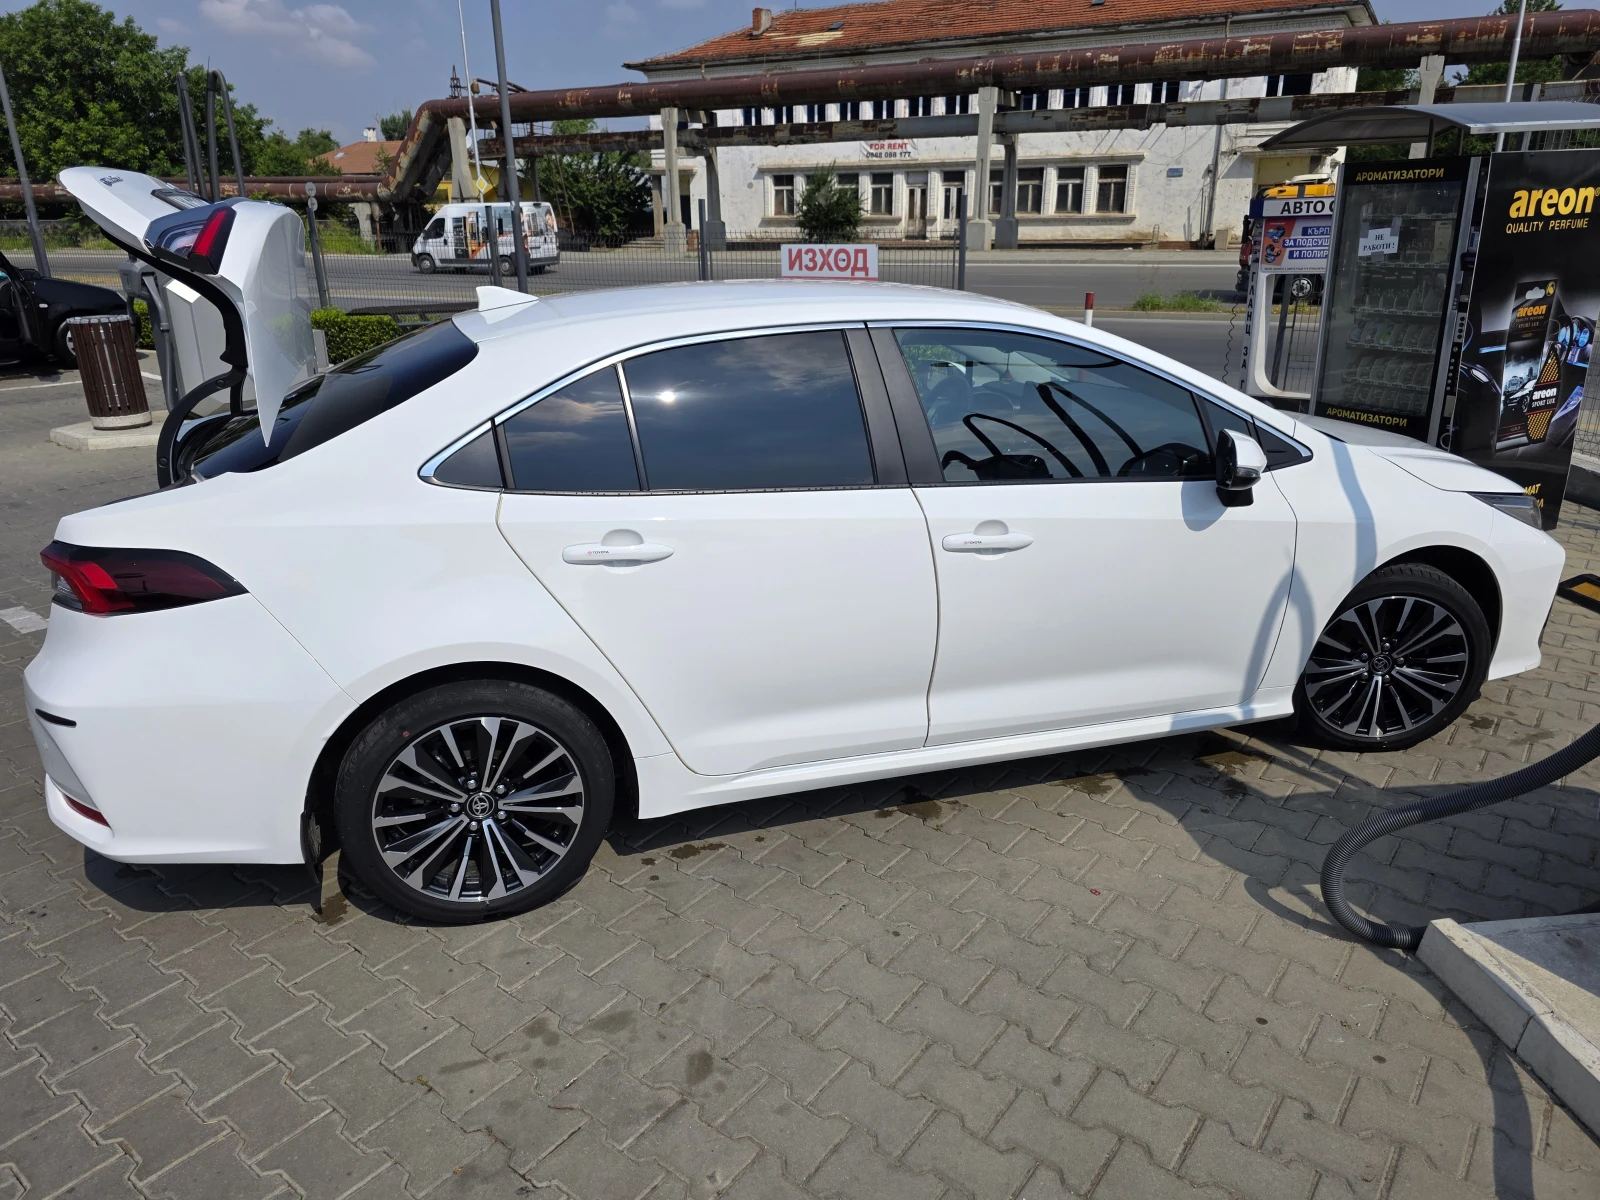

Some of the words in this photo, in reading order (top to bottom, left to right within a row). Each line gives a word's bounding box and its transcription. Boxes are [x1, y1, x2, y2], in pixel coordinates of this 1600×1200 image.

[1356, 168, 1444, 182] АРОМАТИЗАТОРИ
[1280, 200, 1325, 214] АВТО
[1509, 187, 1595, 218] areon
[1506, 221, 1544, 234] QUALITY
[1549, 218, 1589, 230] PERFUME
[788, 248, 869, 276] ИЗХОД
[1517, 305, 1547, 317] areon
[1532, 388, 1557, 400] areon
[1326, 408, 1407, 426] АРОМАТИЗАТОРИ
